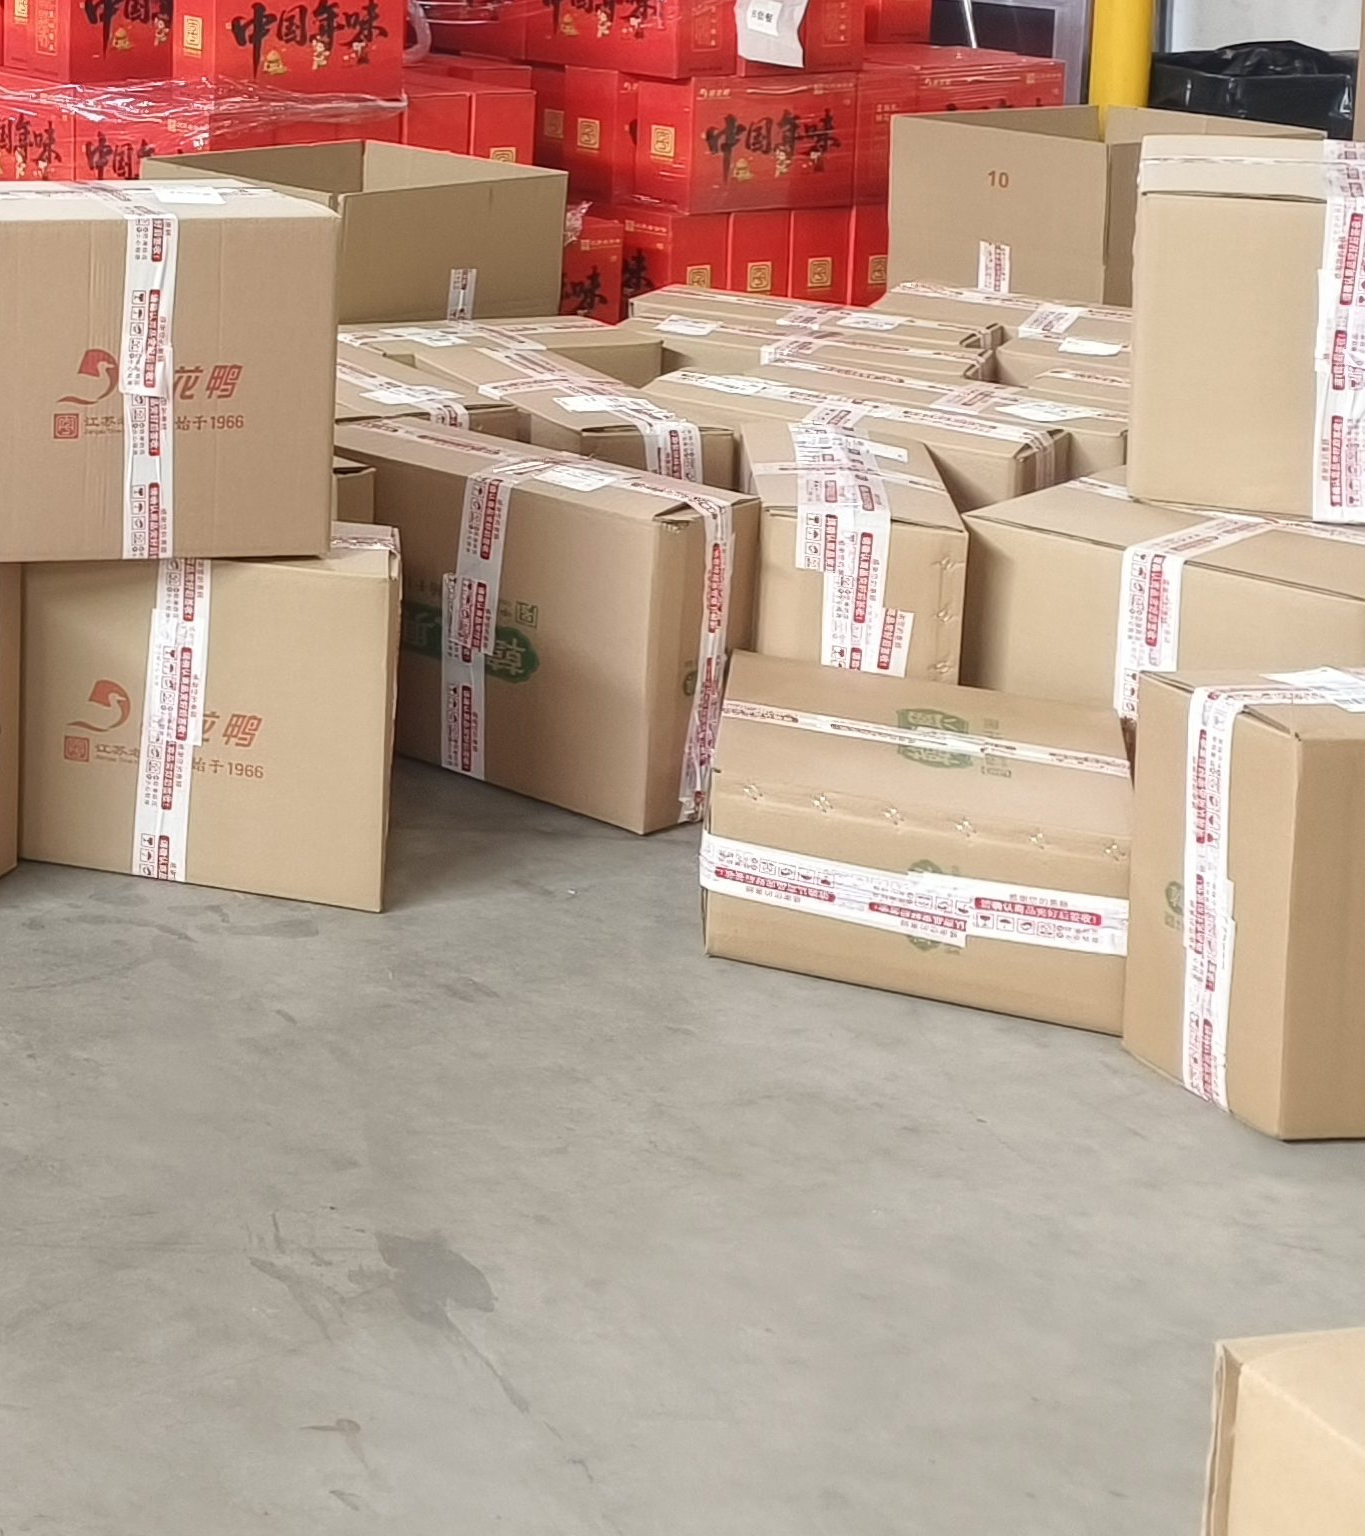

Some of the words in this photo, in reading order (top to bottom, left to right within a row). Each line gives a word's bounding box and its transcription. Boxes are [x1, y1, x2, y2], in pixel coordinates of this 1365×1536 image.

[706, 109, 841, 184] 中国年味
[987, 170, 1009, 189] 10
[174, 365, 243, 400] 花鸭
[149, 396, 161, 456] 品完好后签收!
